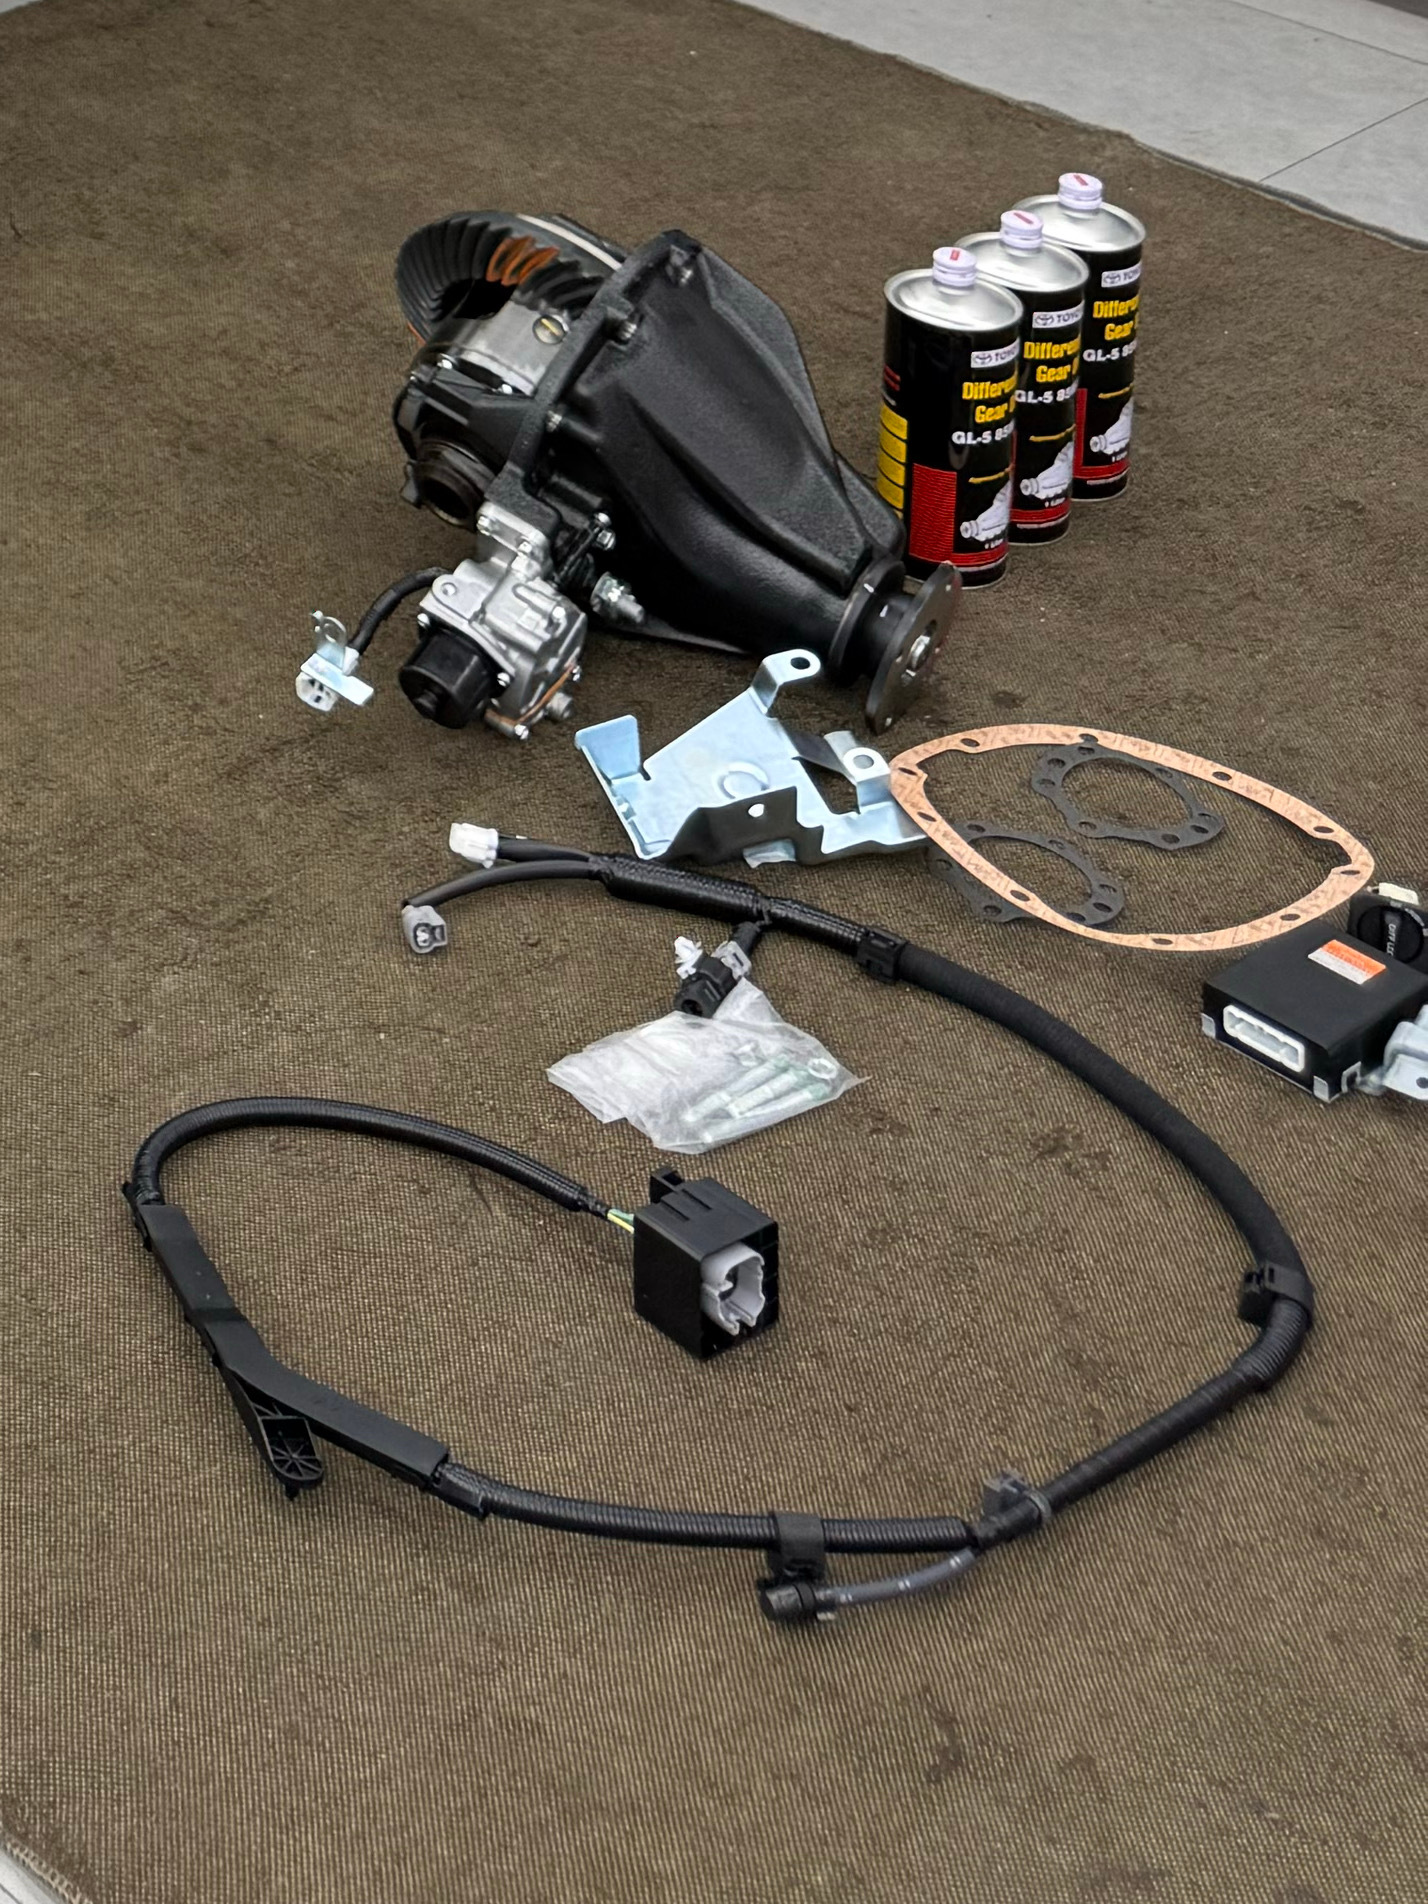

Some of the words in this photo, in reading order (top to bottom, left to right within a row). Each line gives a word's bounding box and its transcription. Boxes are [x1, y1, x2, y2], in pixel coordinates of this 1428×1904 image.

[1035, 364, 1072, 383] Gear
[1015, 389, 1054, 404] GL-5
[975, 403, 1009, 423] Gear
[951, 431, 992, 444] GL-5
